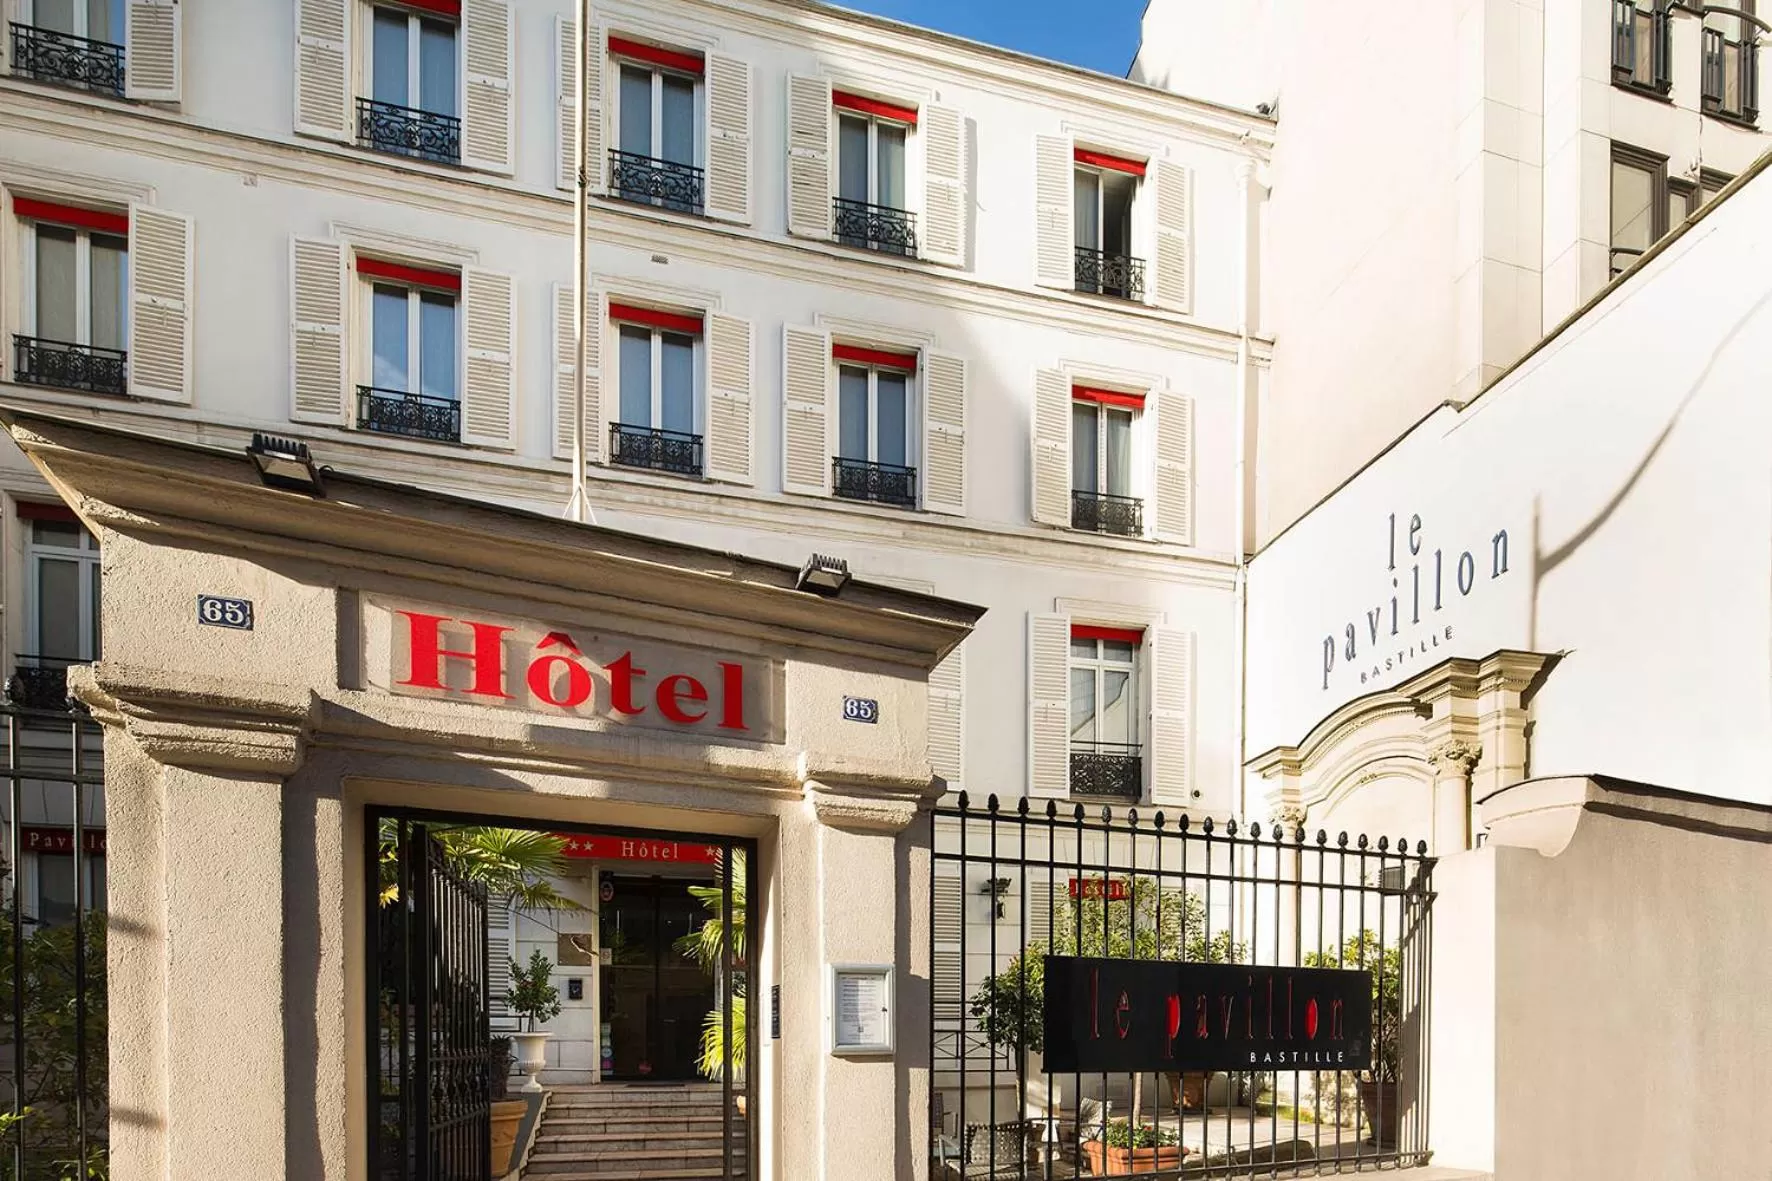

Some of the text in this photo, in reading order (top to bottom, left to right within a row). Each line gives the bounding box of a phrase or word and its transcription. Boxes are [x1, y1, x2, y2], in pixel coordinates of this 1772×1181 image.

[1388, 512, 1422, 572] le
[202, 599, 245, 625] 65
[1322, 528, 1509, 691] pavillon
[394, 610, 751, 732] Hôtel
[1360, 625, 1454, 685] BASTILLE
[845, 698, 873, 719] 65
[621, 840, 679, 860] Hôtel
[1089, 967, 1346, 1059] le pavillon
[1249, 1050, 1345, 1064] BASTILLE
